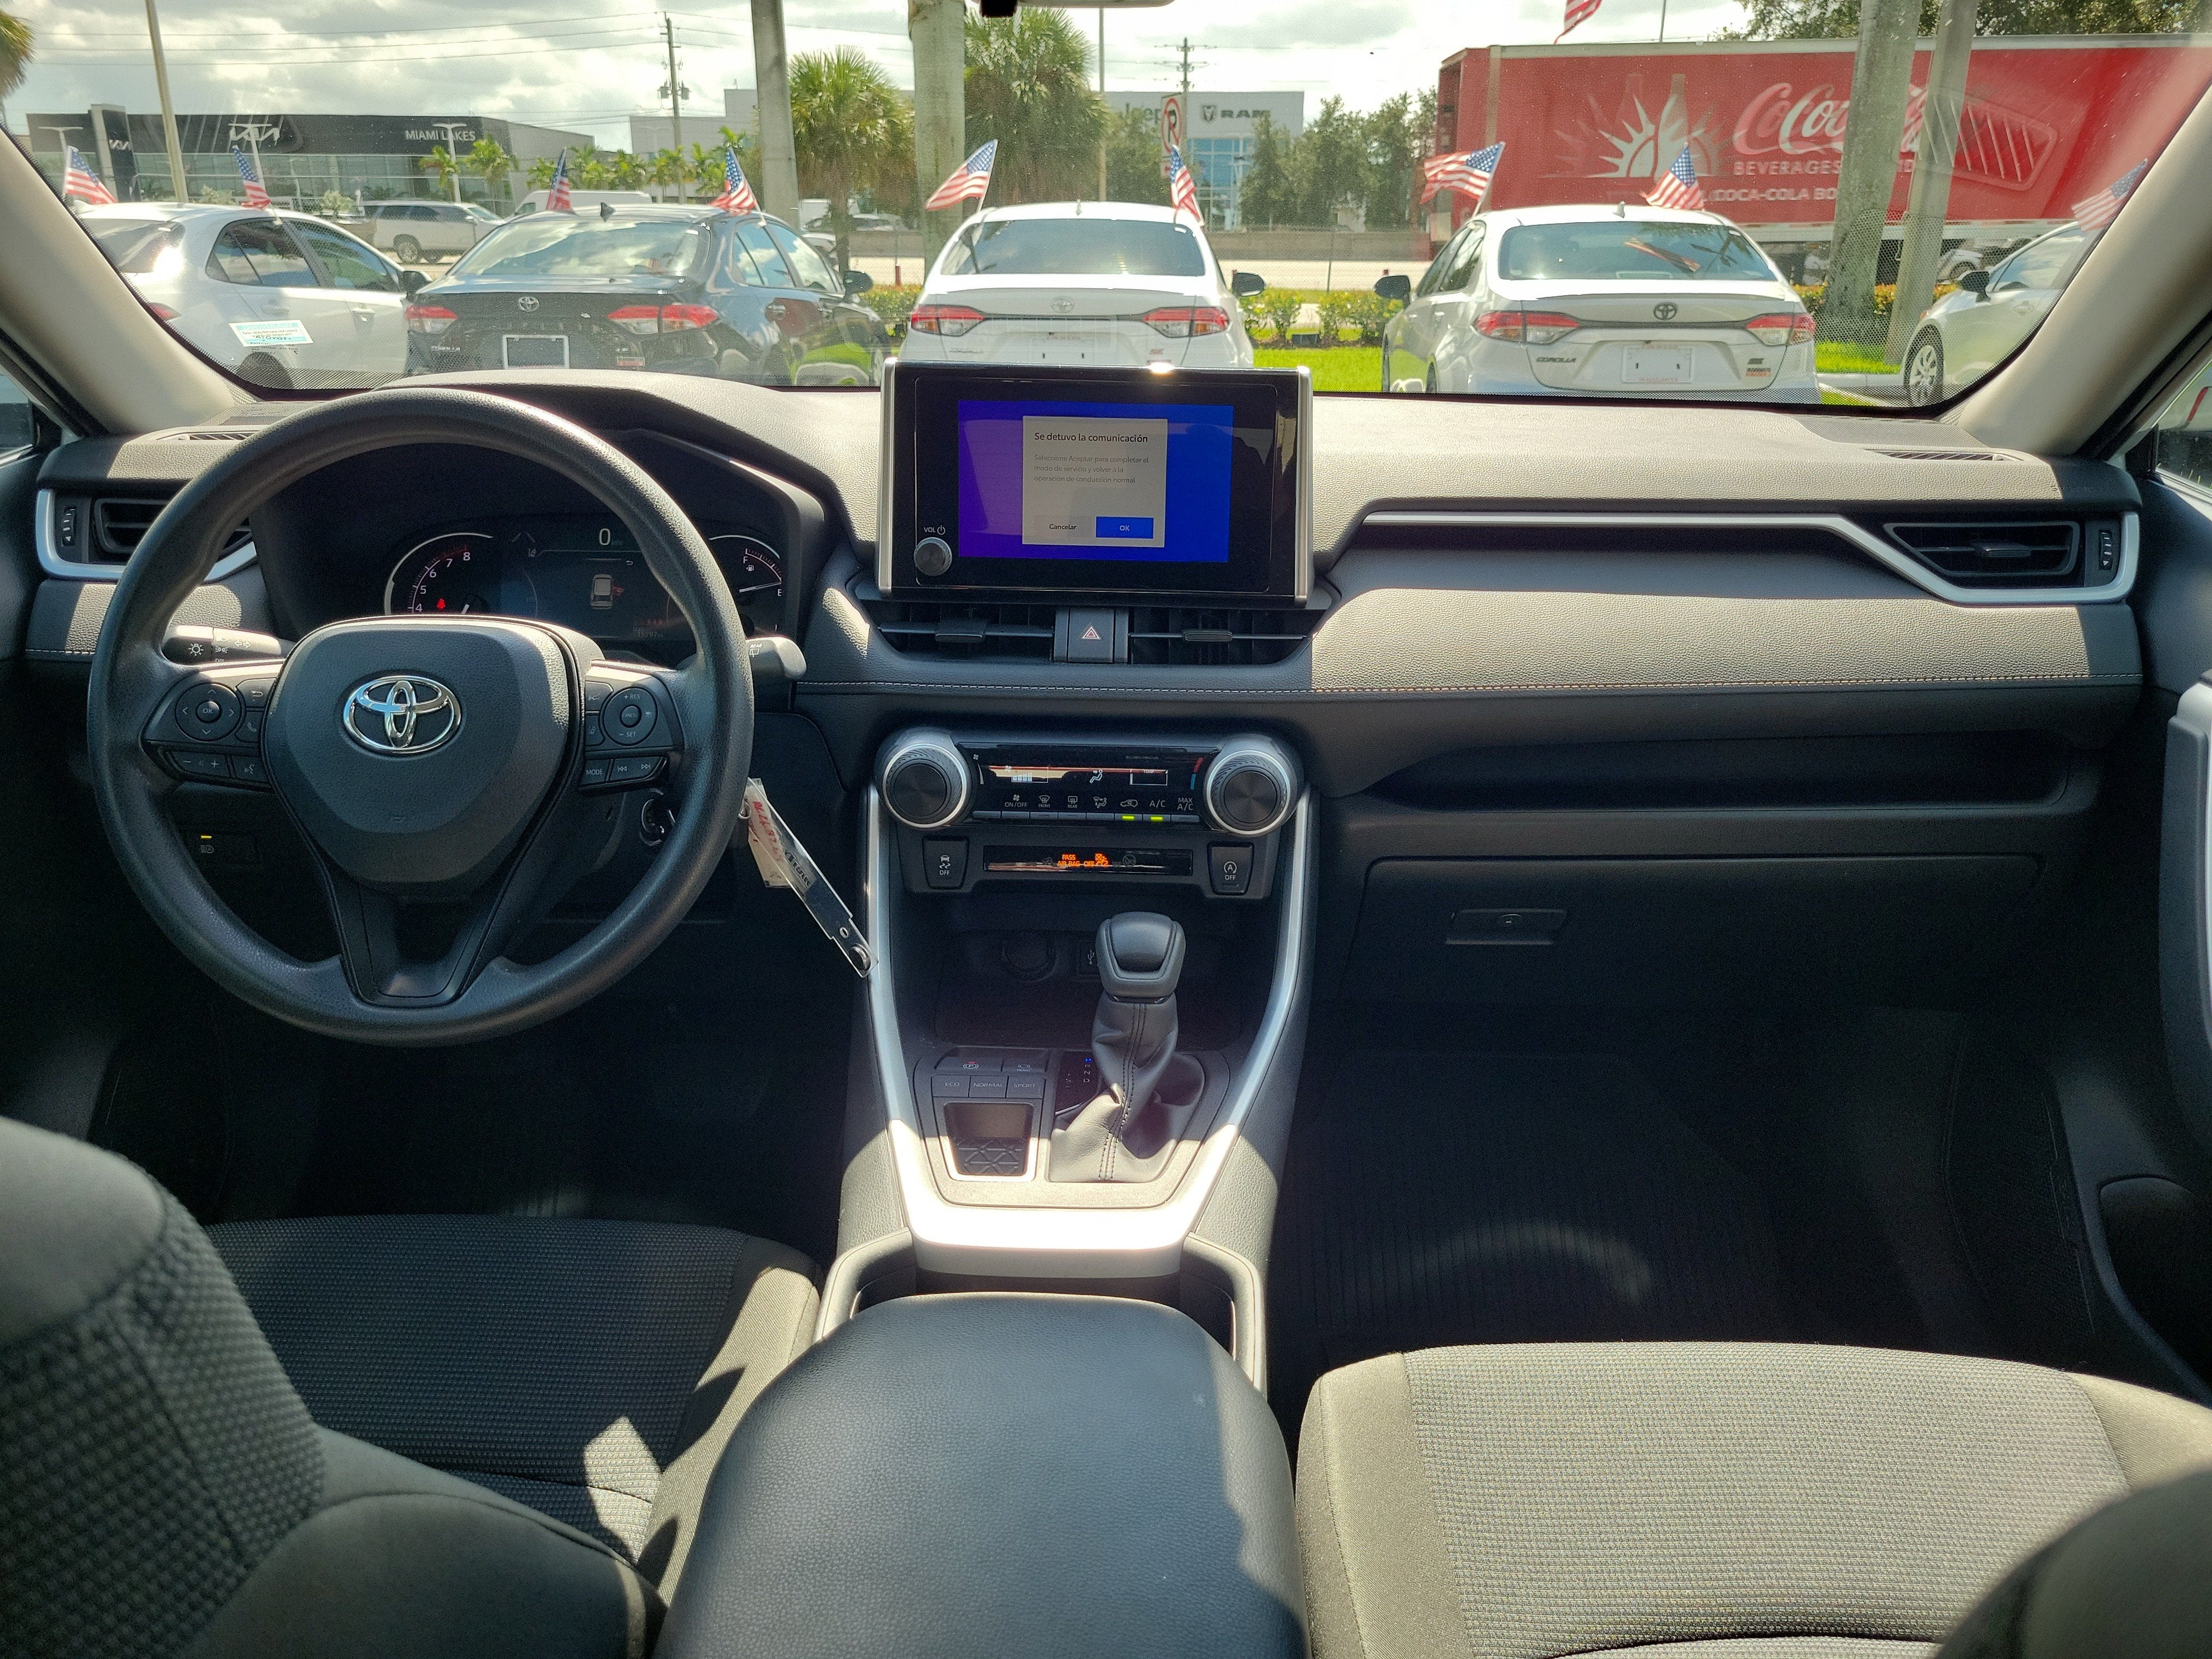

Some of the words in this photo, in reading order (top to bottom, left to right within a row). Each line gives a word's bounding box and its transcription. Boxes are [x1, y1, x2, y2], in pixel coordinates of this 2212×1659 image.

[405, 129, 439, 140] MIAMI
[441, 129, 476, 141] LKES
[1035, 432, 1045, 441] Se
[1047, 432, 1076, 441] detuvo
[1078, 433, 1086, 441] la
[1088, 433, 1148, 443] comunicación
[599, 528, 611, 546] 0
[463, 552, 471, 561] 8
[743, 556, 748, 564] F
[446, 558, 453, 568] 7
[429, 569, 437, 578] 6
[420, 585, 427, 594] 5
[777, 589, 782, 597] E
[415, 603, 423, 613] 4
[1149, 799, 1166, 808] A/C
[1177, 803, 1194, 811] A/C
